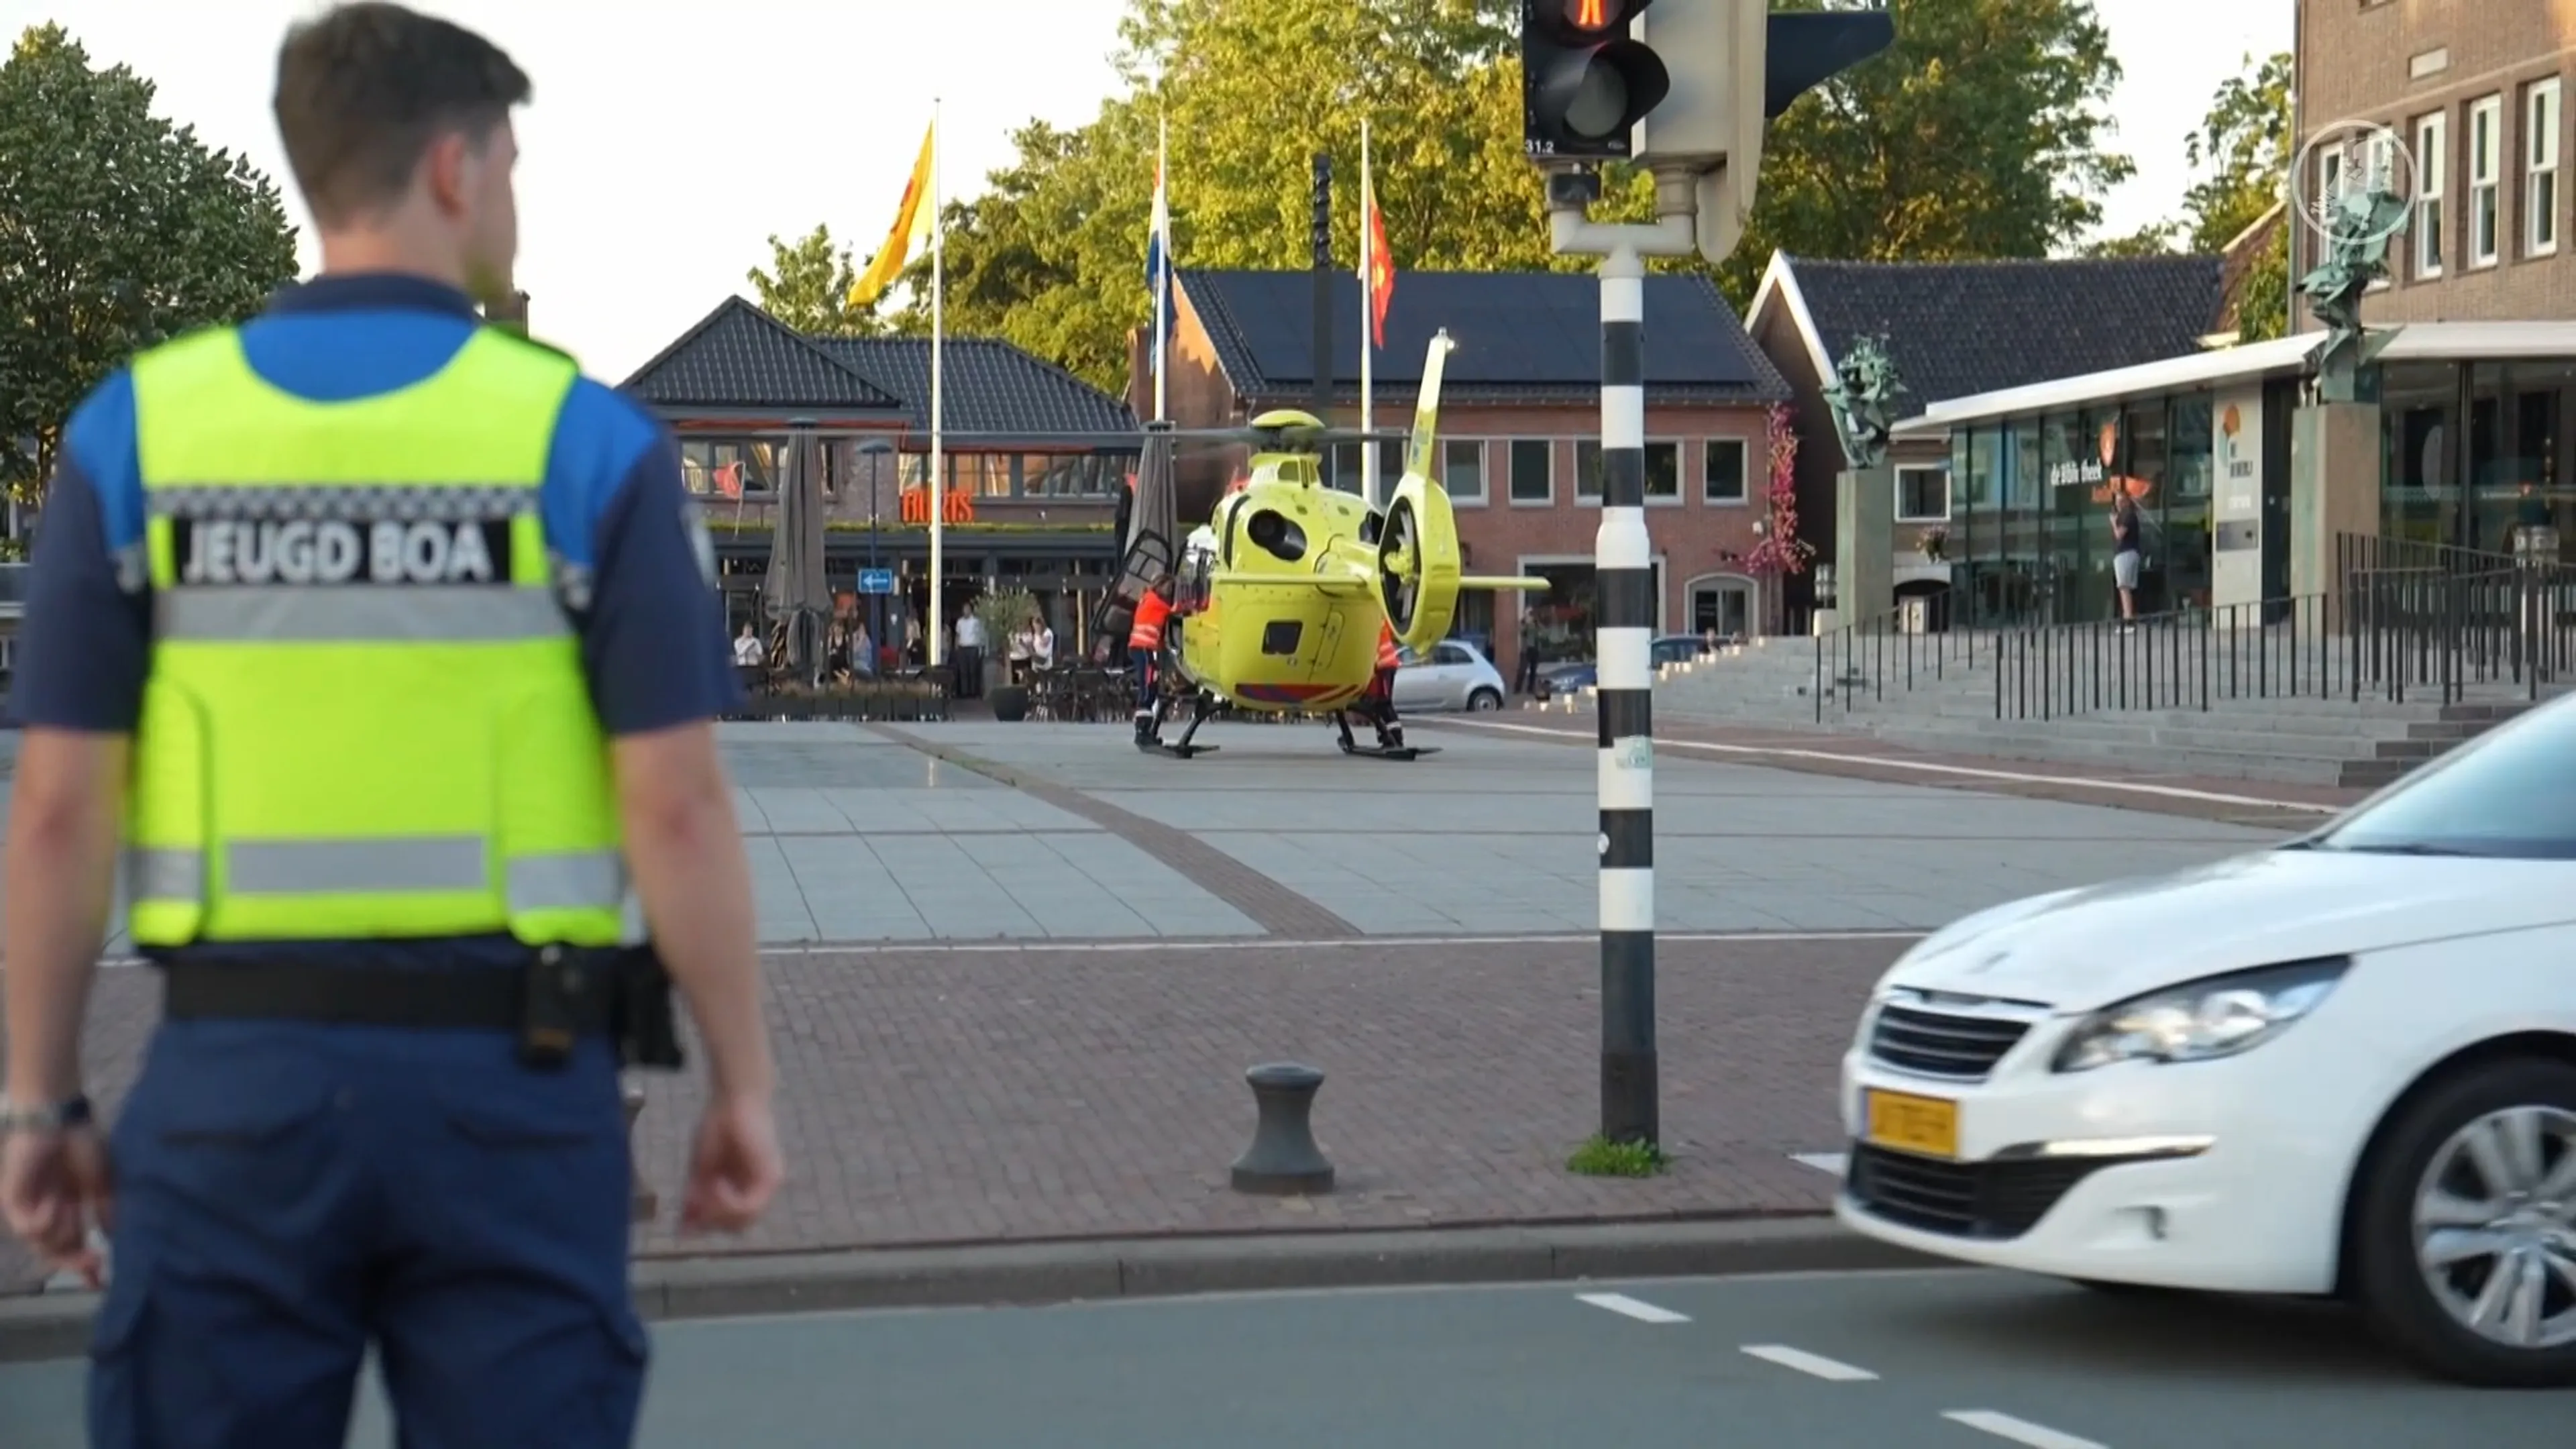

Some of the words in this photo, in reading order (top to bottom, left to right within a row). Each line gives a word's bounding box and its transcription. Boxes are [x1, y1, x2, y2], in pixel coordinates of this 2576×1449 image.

[1525, 139, 1554, 154] 31.2
[184, 519, 362, 584] JEUGD
[369, 519, 494, 584] BOA
